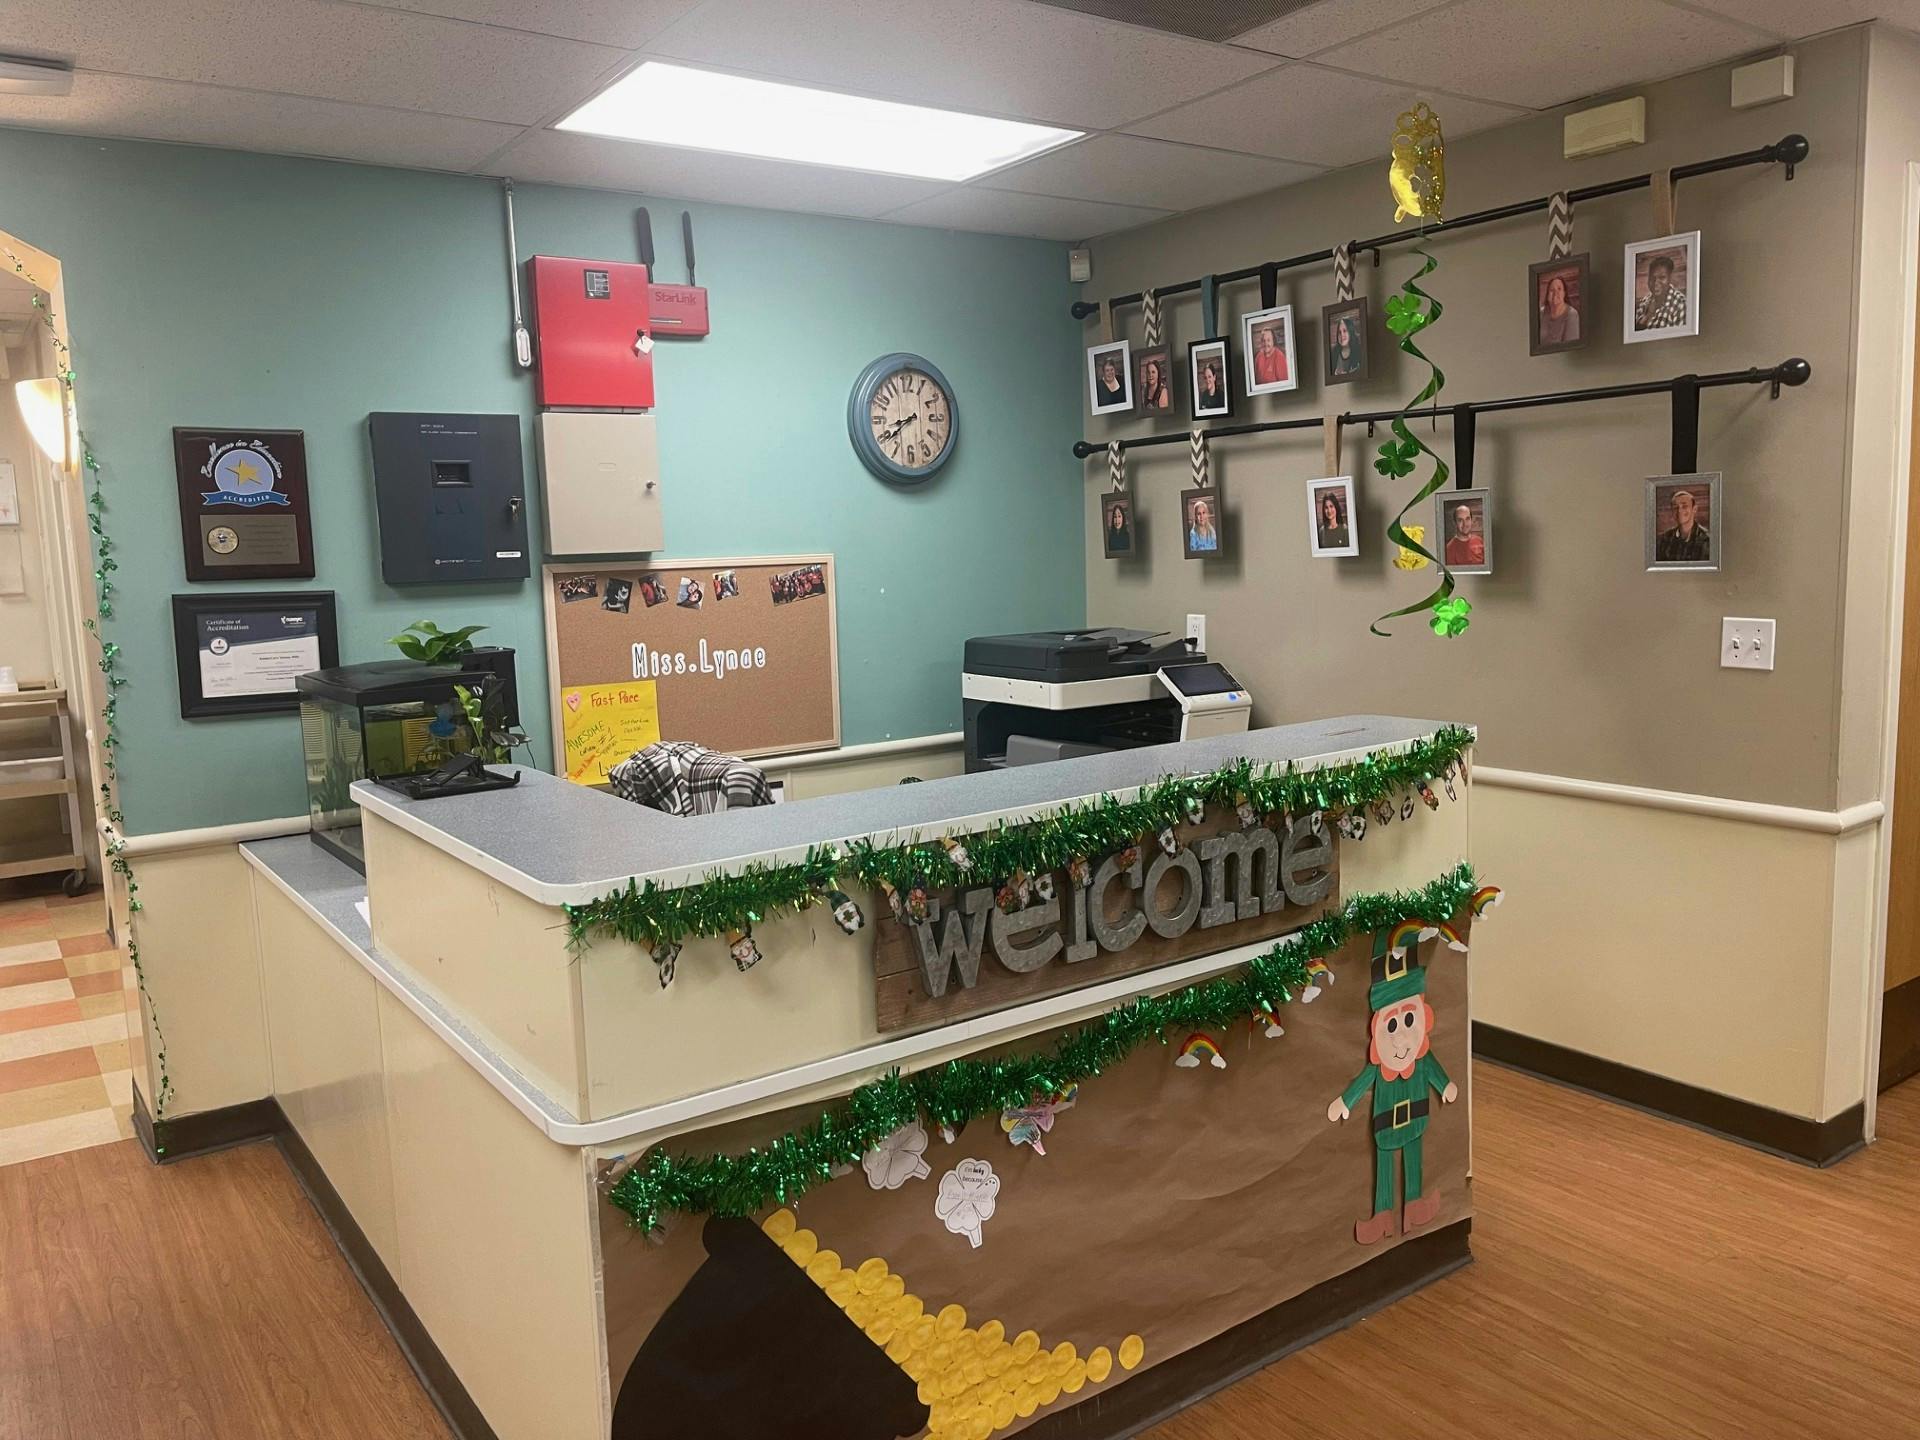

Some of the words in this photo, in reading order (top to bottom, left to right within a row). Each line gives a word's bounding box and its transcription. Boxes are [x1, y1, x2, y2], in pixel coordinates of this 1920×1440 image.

[655, 291, 696, 305] StarLink
[899, 374, 914, 393] 12
[928, 413, 945, 423] 3
[906, 444, 915, 464] 6
[590, 691, 615, 708] Fast
[566, 720, 606, 753] AWESOME
[905, 815, 1336, 998] welcome
